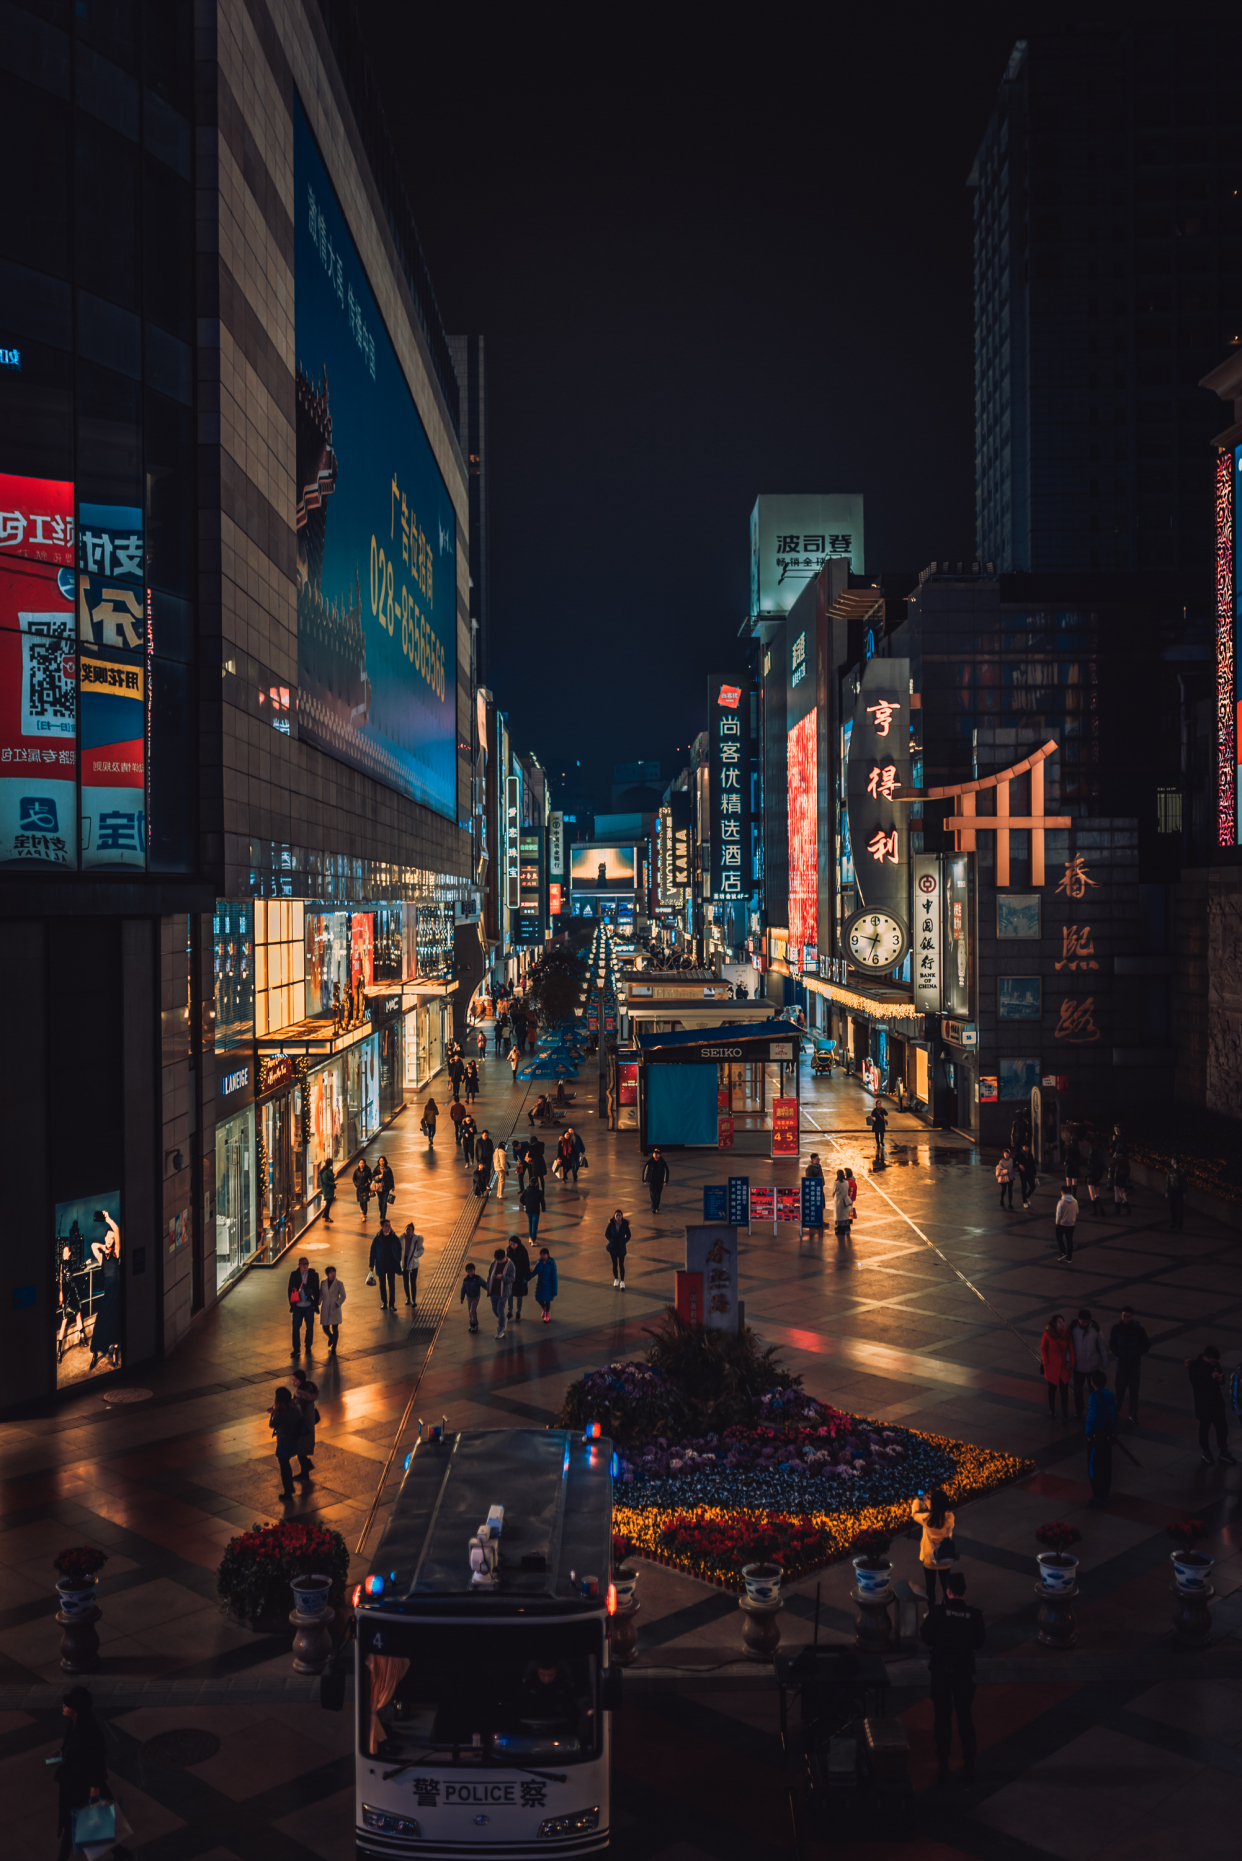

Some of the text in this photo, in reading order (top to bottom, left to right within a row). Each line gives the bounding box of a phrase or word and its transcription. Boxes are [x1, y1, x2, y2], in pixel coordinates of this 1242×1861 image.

[390, 471, 434, 611] 广告位招商
[776, 534, 852, 554] 波司登
[369, 533, 446, 704] 028-85565566
[865, 698, 903, 866] 亨得利
[720, 715, 741, 892] 尚客优精选酒店
[675, 829, 687, 883] KAMA
[851, 934, 900, 946] 9 3
[871, 952, 880, 966] 6
[1054, 852, 1102, 1044] 春熙路
[700, 1047, 743, 1058] SEIKO
[225, 1066, 248, 1095] LANEIGE
[706, 1239, 731, 1314] 春熙路
[372, 1632, 383, 1649] 4
[413, 1778, 547, 1808] 警 POLICE 察
